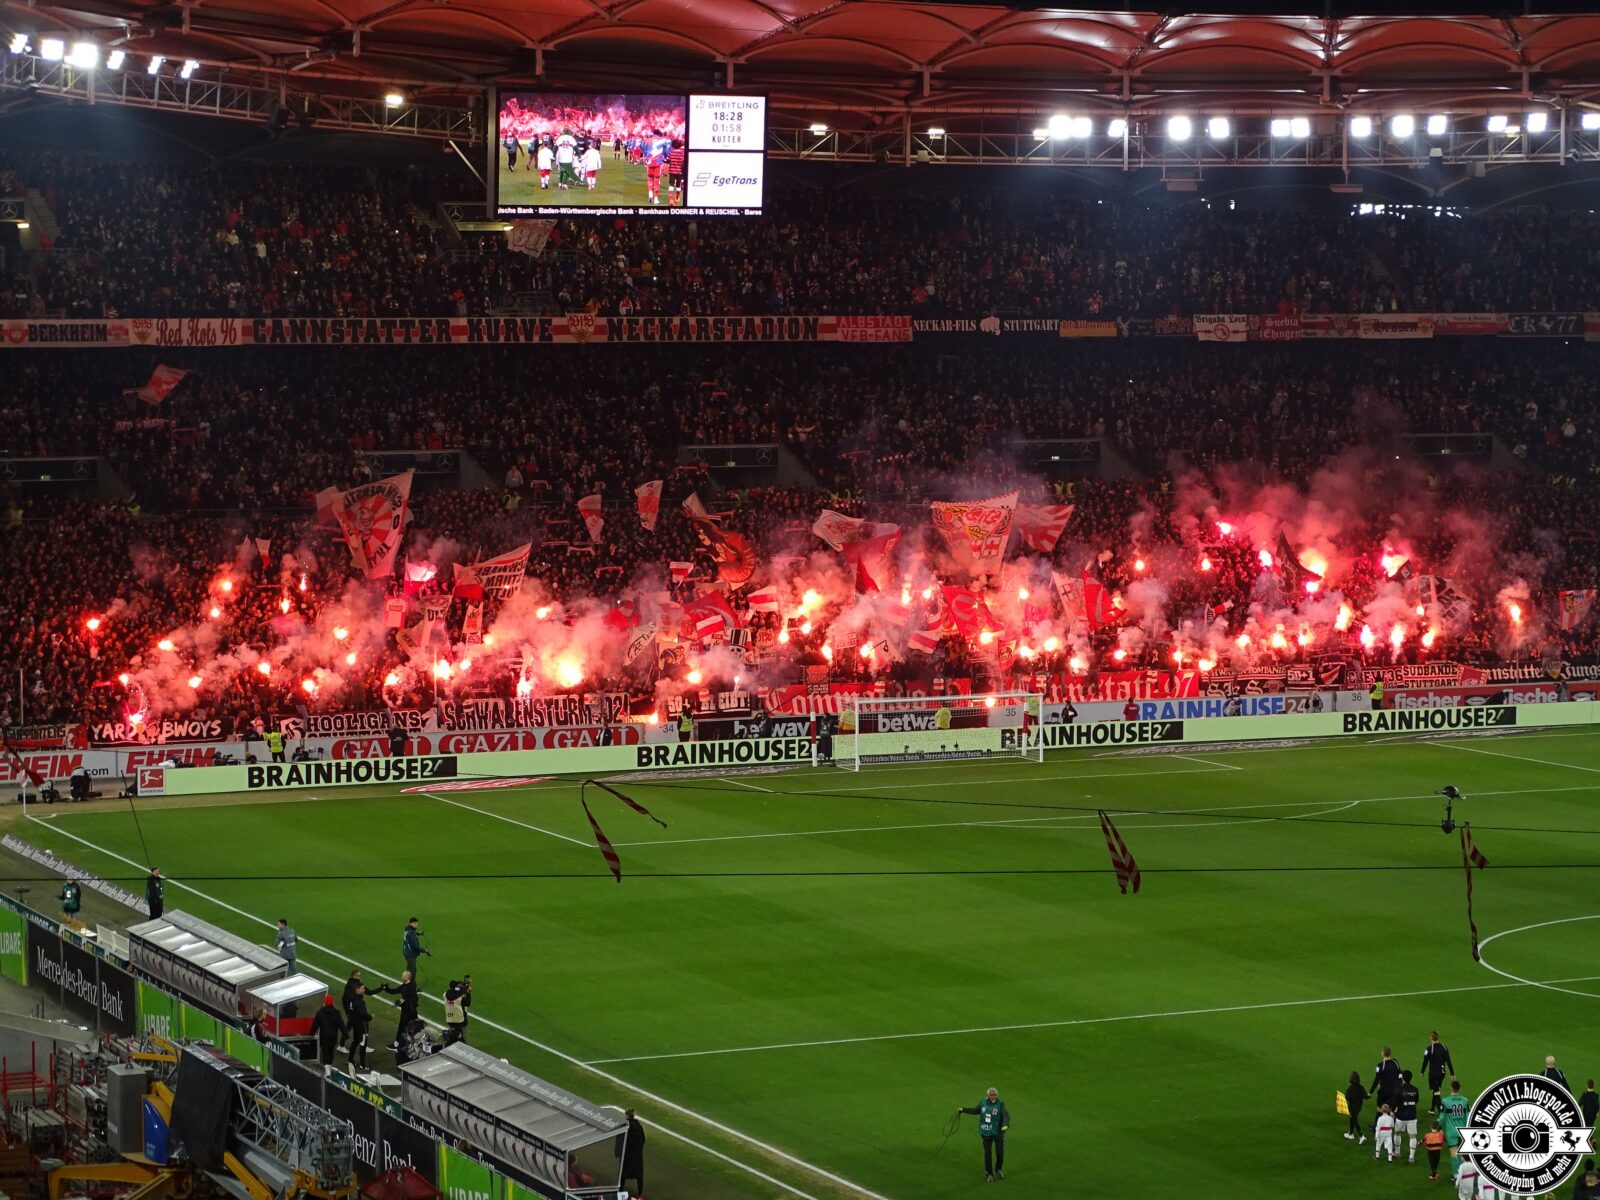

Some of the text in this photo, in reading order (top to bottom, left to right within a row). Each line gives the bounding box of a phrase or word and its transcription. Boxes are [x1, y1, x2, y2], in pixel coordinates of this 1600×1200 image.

[708, 101, 759, 110] BREITLING
[713, 112, 743, 122] 18:28
[712, 124, 742, 133] 01:58
[712, 135, 742, 144] KUTTER
[712, 175, 758, 187] EgeTrans
[517, 207, 534, 215] Bank
[639, 208, 670, 216] Bankhaus
[670, 208, 699, 216] DONNER
[705, 208, 740, 216] REUSCHEL
[28, 324, 108, 342] BERKHEIM
[155, 319, 184, 347] Red
[220, 317, 237, 344] 96
[252, 316, 819, 344] CANNSTATTER KURVE NECKARSTADION
[913, 319, 1060, 332] NECKAR-FILS STUTTGART
[1348, 669, 1387, 684] CEW
[1404, 679, 1458, 690] STUTTGART
[1351, 693, 1362, 703] 36
[1394, 692, 1461, 710] fischer
[1503, 687, 1558, 706] fische
[1005, 707, 1016, 718] 35
[308, 710, 423, 733] HOOLIGANS
[734, 719, 811, 739] beway
[877, 713, 938, 732] betwa
[553, 727, 629, 748] GAI
[342, 737, 421, 760] GAI
[36, 946, 98, 1008] Mercedes-Benz
[101, 981, 124, 1022] Bank
